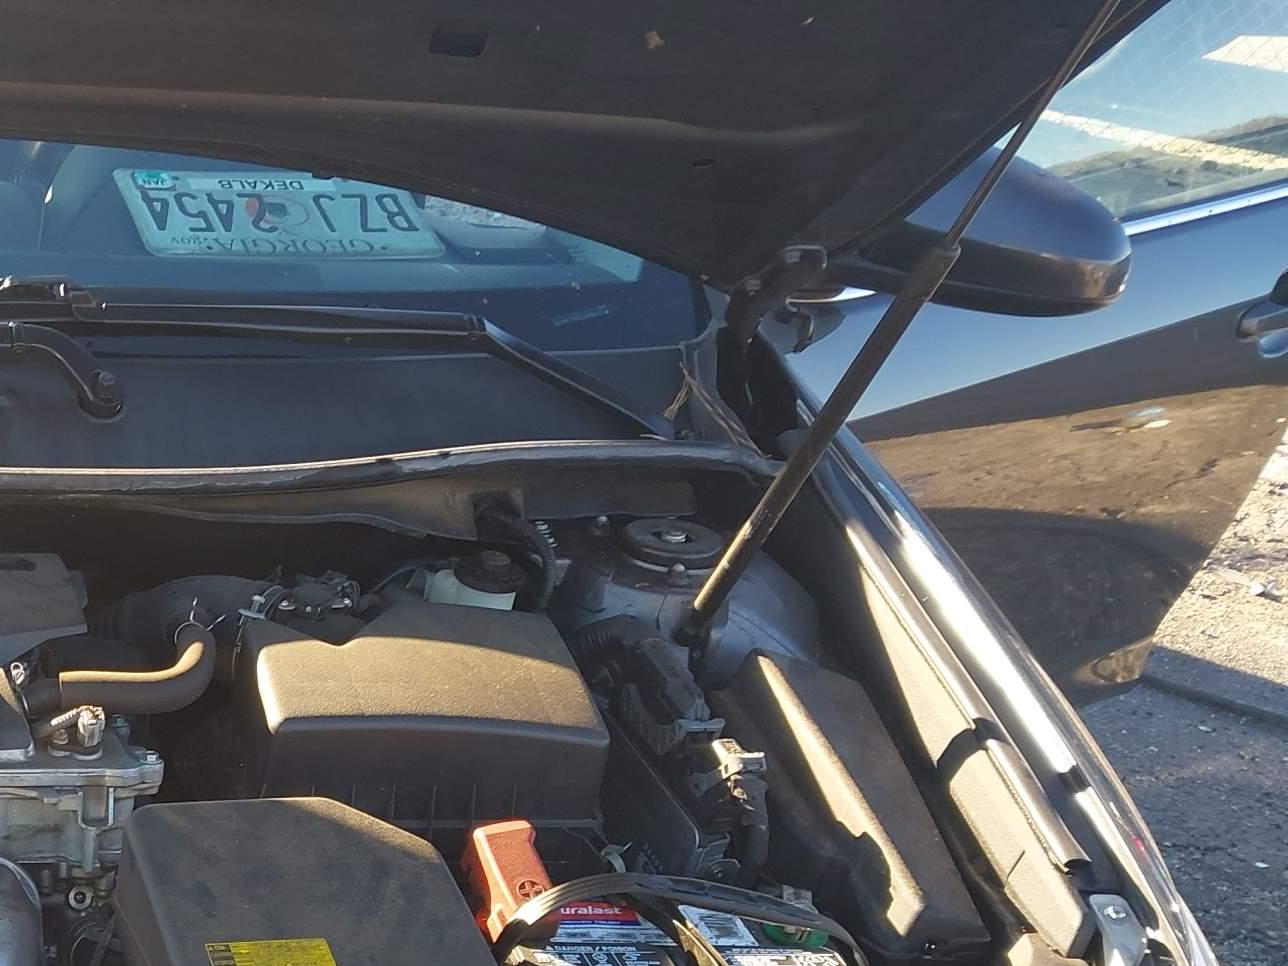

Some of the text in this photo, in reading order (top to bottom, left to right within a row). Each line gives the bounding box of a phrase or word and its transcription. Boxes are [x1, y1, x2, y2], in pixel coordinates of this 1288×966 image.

[218, 179, 304, 190] DEKALB
[139, 190, 420, 233] BZJ 2454
[211, 238, 375, 254] GEORGIA
[559, 904, 623, 915] uralast
